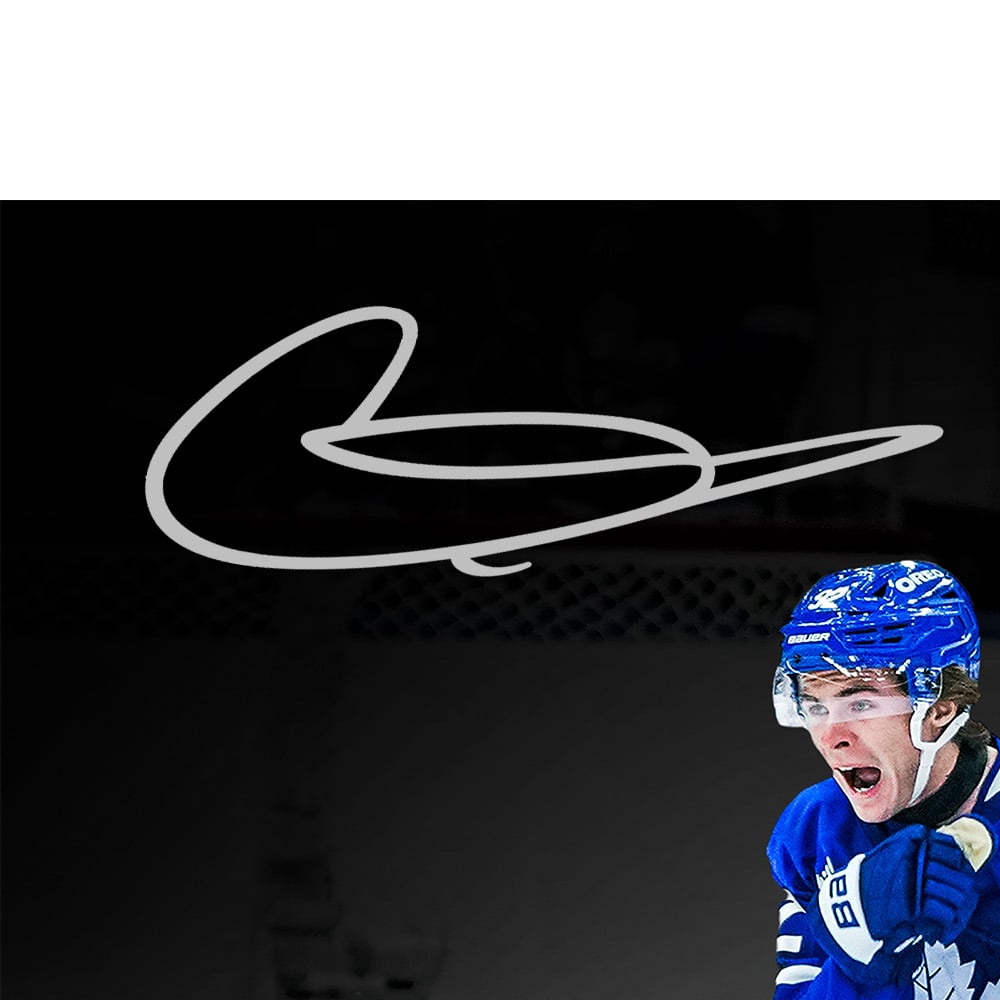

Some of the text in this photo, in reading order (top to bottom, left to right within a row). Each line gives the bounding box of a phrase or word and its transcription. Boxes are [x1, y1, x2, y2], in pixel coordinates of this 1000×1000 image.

[895, 568, 945, 593] OREO
[807, 585, 850, 611] 92
[787, 631, 831, 645] BAUER
